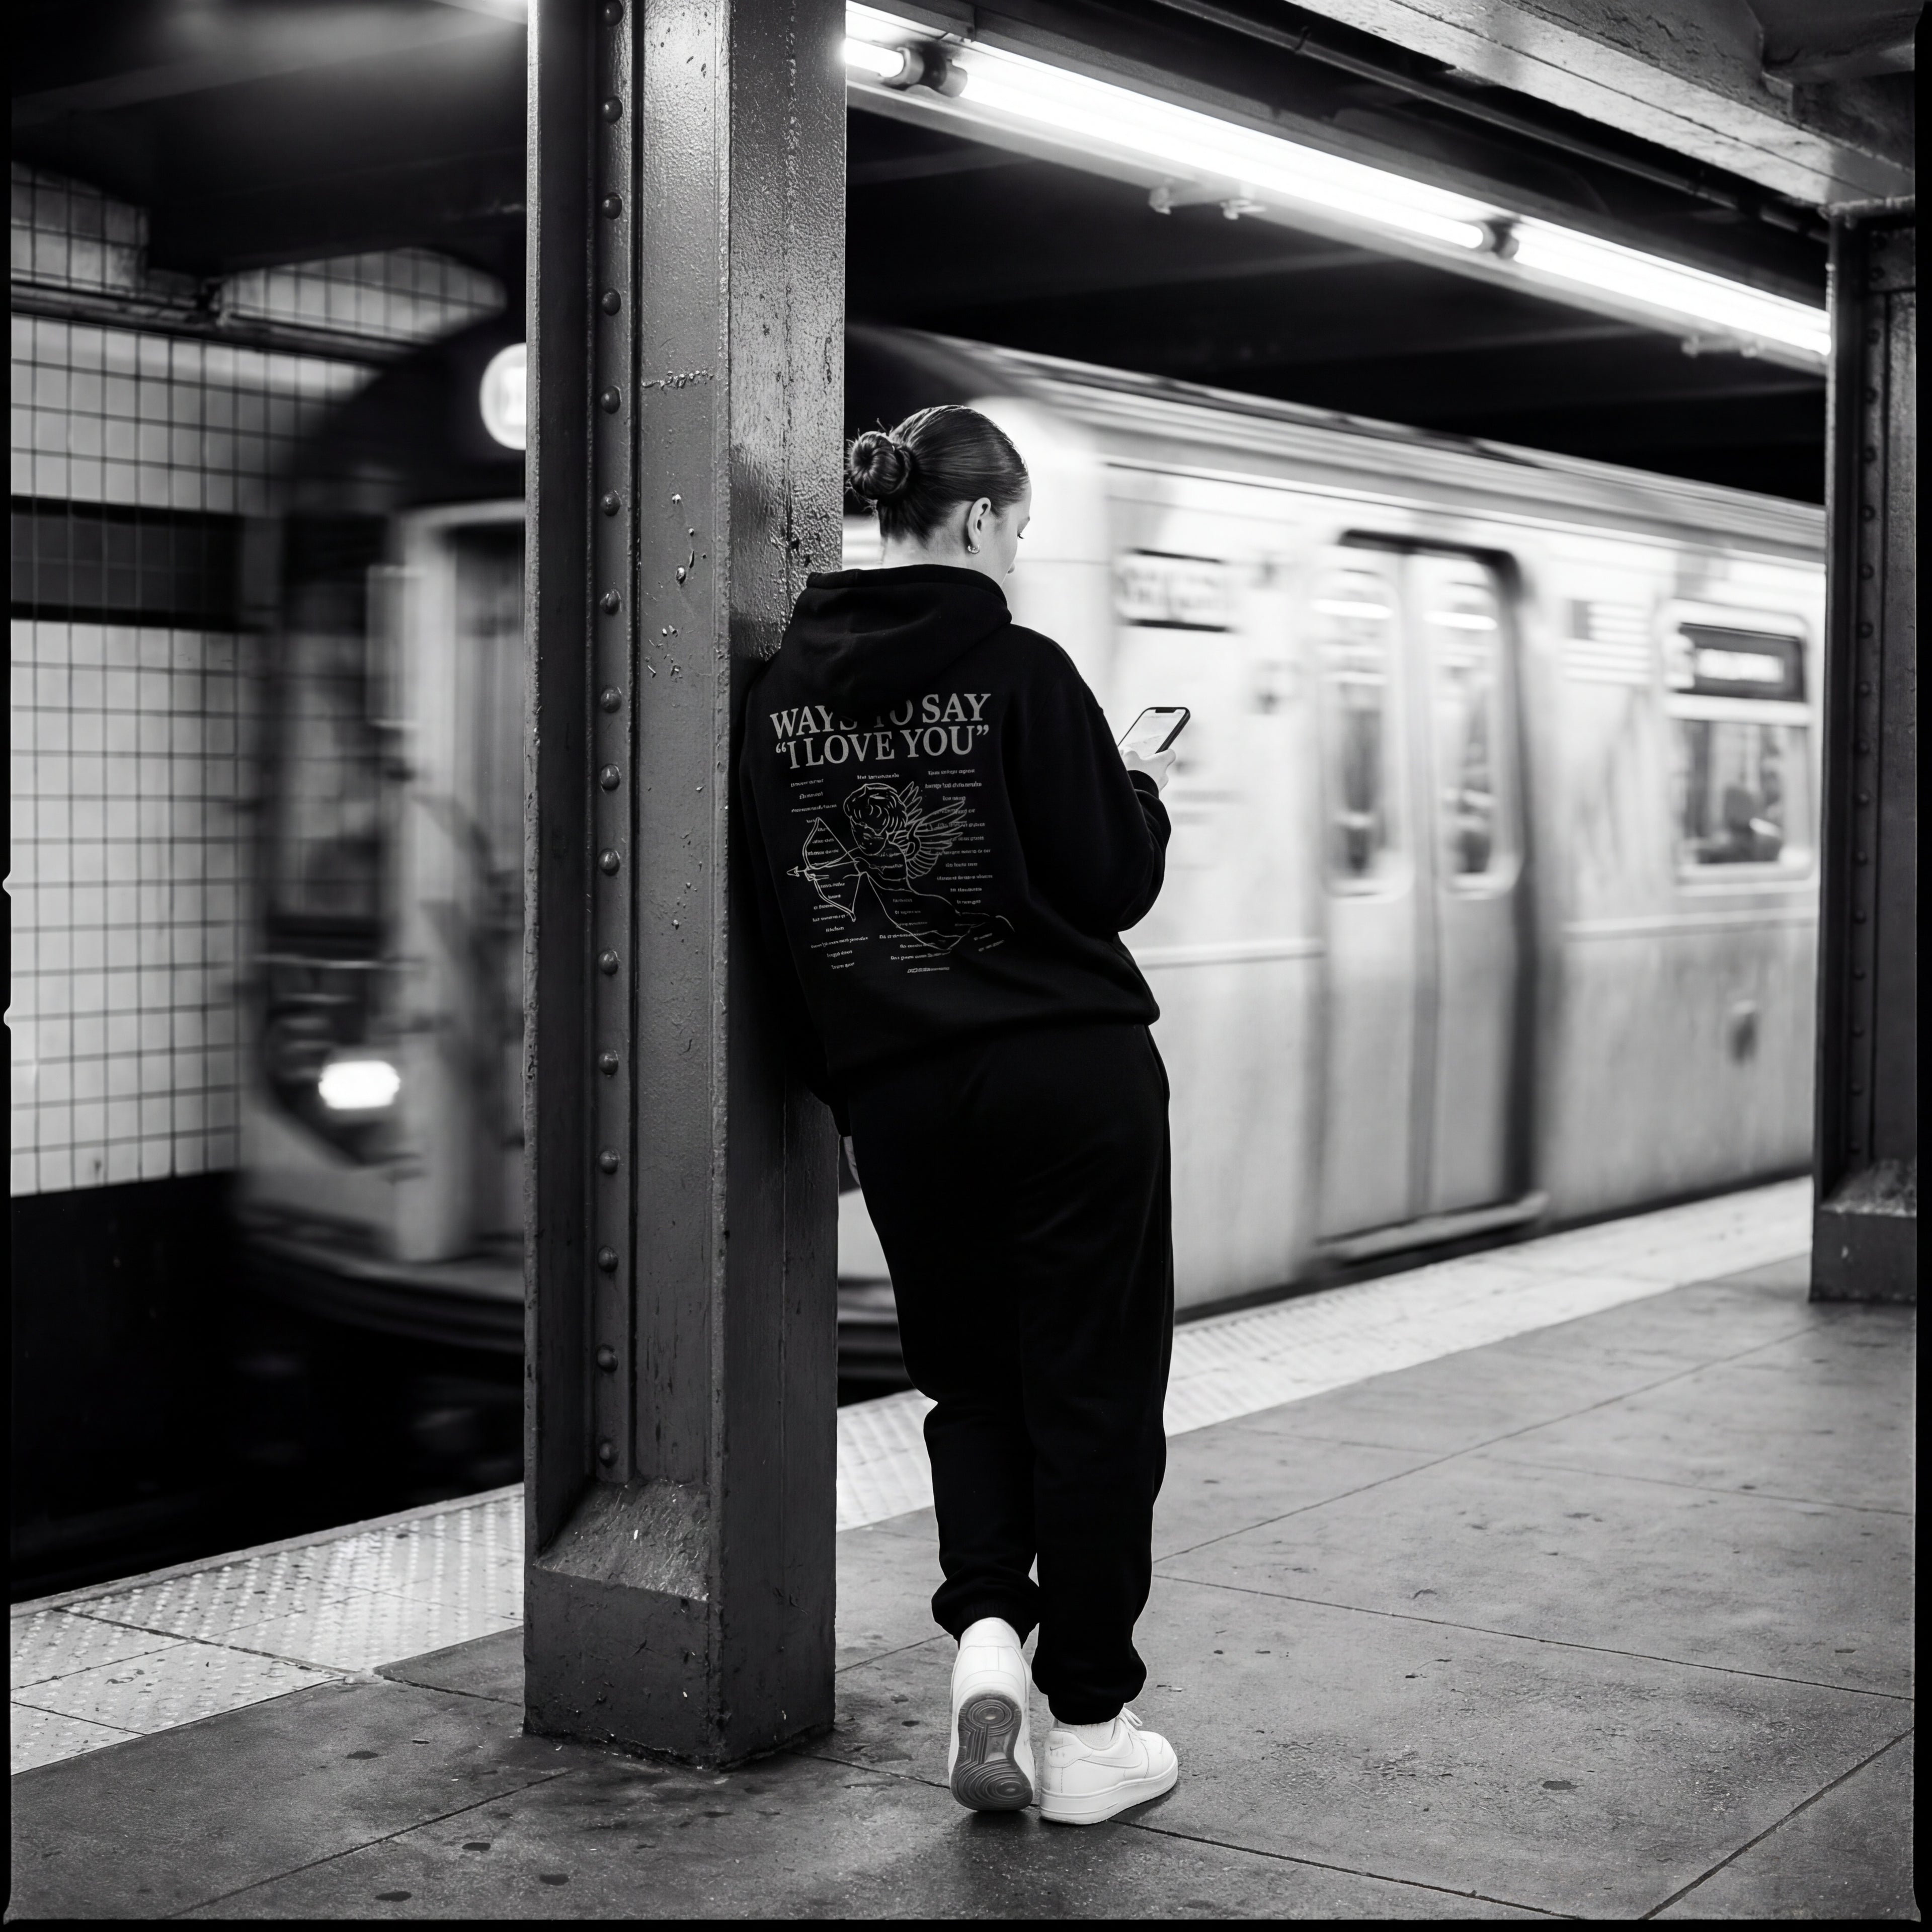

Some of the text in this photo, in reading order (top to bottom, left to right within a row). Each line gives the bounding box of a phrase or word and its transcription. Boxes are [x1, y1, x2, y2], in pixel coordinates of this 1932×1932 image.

[922, 693, 991, 723] SAY
[803, 732, 895, 766] LOVE
[900, 725, 989, 757] YOU”
